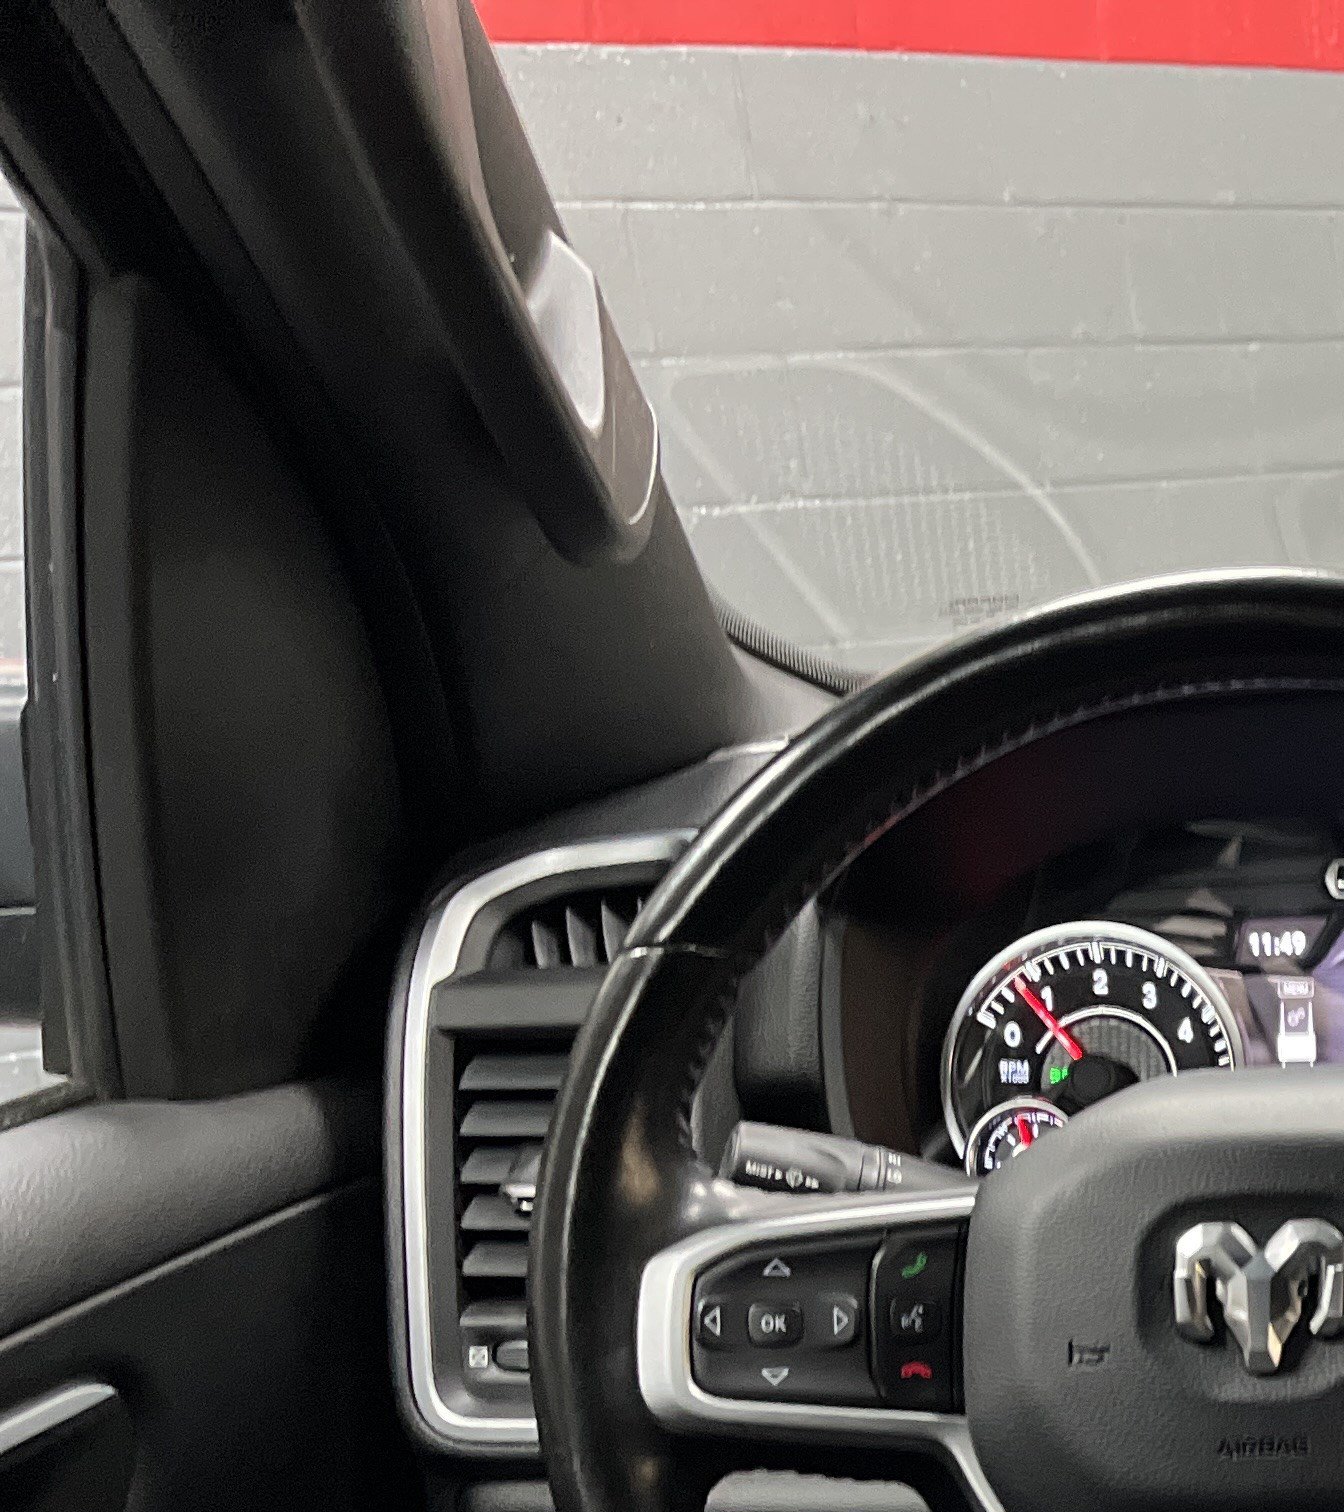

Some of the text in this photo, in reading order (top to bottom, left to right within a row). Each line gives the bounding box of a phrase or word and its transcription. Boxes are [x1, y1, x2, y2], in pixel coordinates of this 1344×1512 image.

[1249, 930, 1306, 957] 11:49
[1093, 968, 1109, 995] 2
[1040, 986, 1053, 1011] 1
[1142, 981, 1157, 1009] 3
[1004, 1021, 1021, 1047] 0
[1177, 1018, 1194, 1044] 4
[760, 1314, 787, 1334] OK
[1217, 1435, 1309, 1461] AIRBAG
